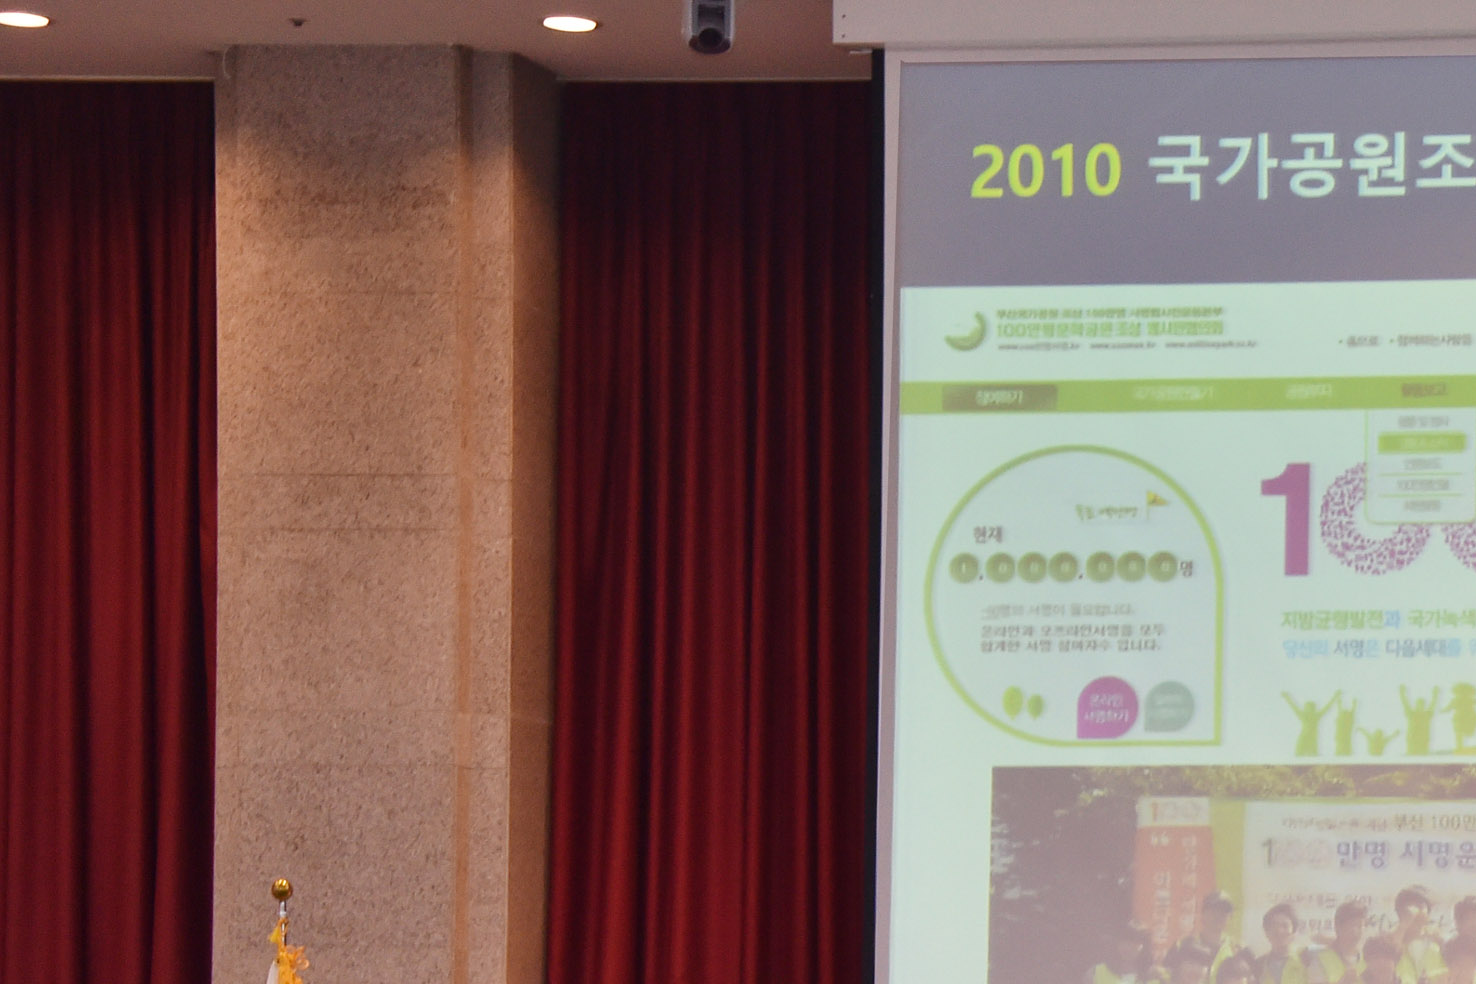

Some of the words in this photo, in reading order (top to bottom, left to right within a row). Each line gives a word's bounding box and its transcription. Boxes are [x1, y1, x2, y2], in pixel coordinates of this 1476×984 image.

[970, 143, 1122, 199] 2010
[973, 526, 1004, 544] 현재
[1281, 609, 1400, 630] 지방균형발전과
[980, 624, 1036, 639] 온라인과
[1139, 623, 1165, 637] 모두
[1026, 640, 1053, 653] 서명
[1282, 639, 1330, 660] 당신의
[1333, 638, 1379, 659] 서명은
[1385, 637, 1462, 658] 다음세대를
